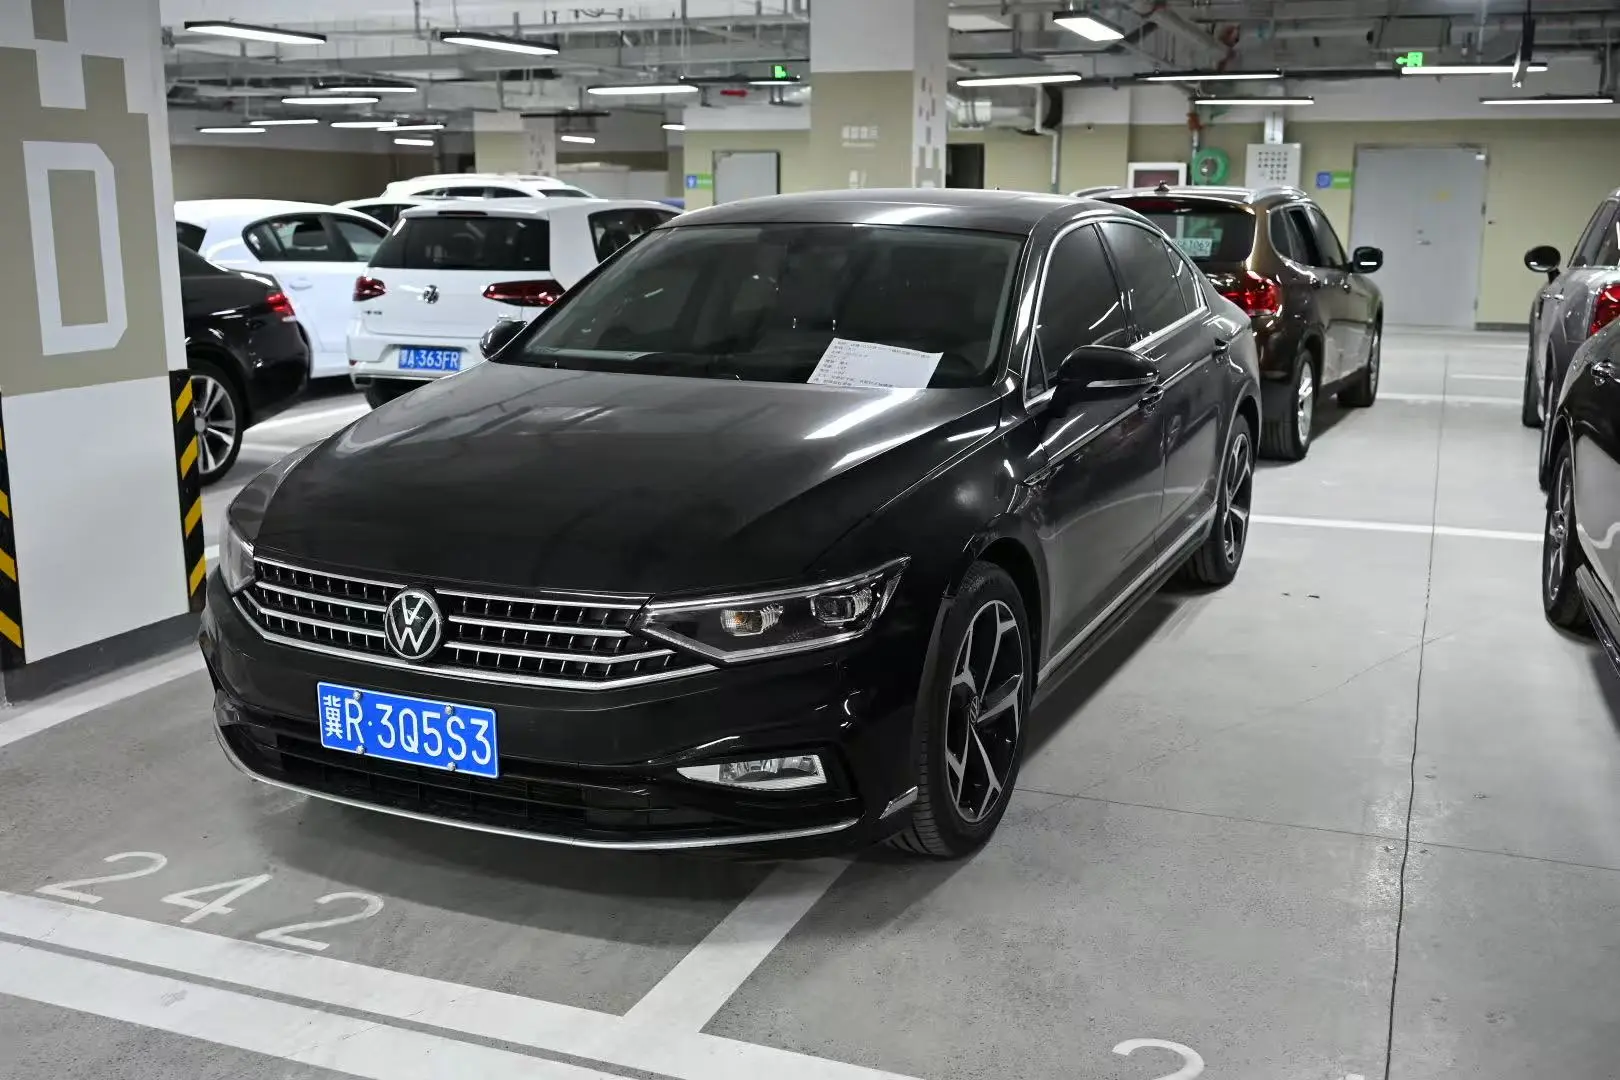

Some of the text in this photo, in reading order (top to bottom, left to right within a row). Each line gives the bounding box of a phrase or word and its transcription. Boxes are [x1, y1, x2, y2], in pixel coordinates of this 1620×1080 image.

[23, 140, 128, 356] D
[399, 349, 460, 371] A·363FR
[35, 850, 385, 952] 242
